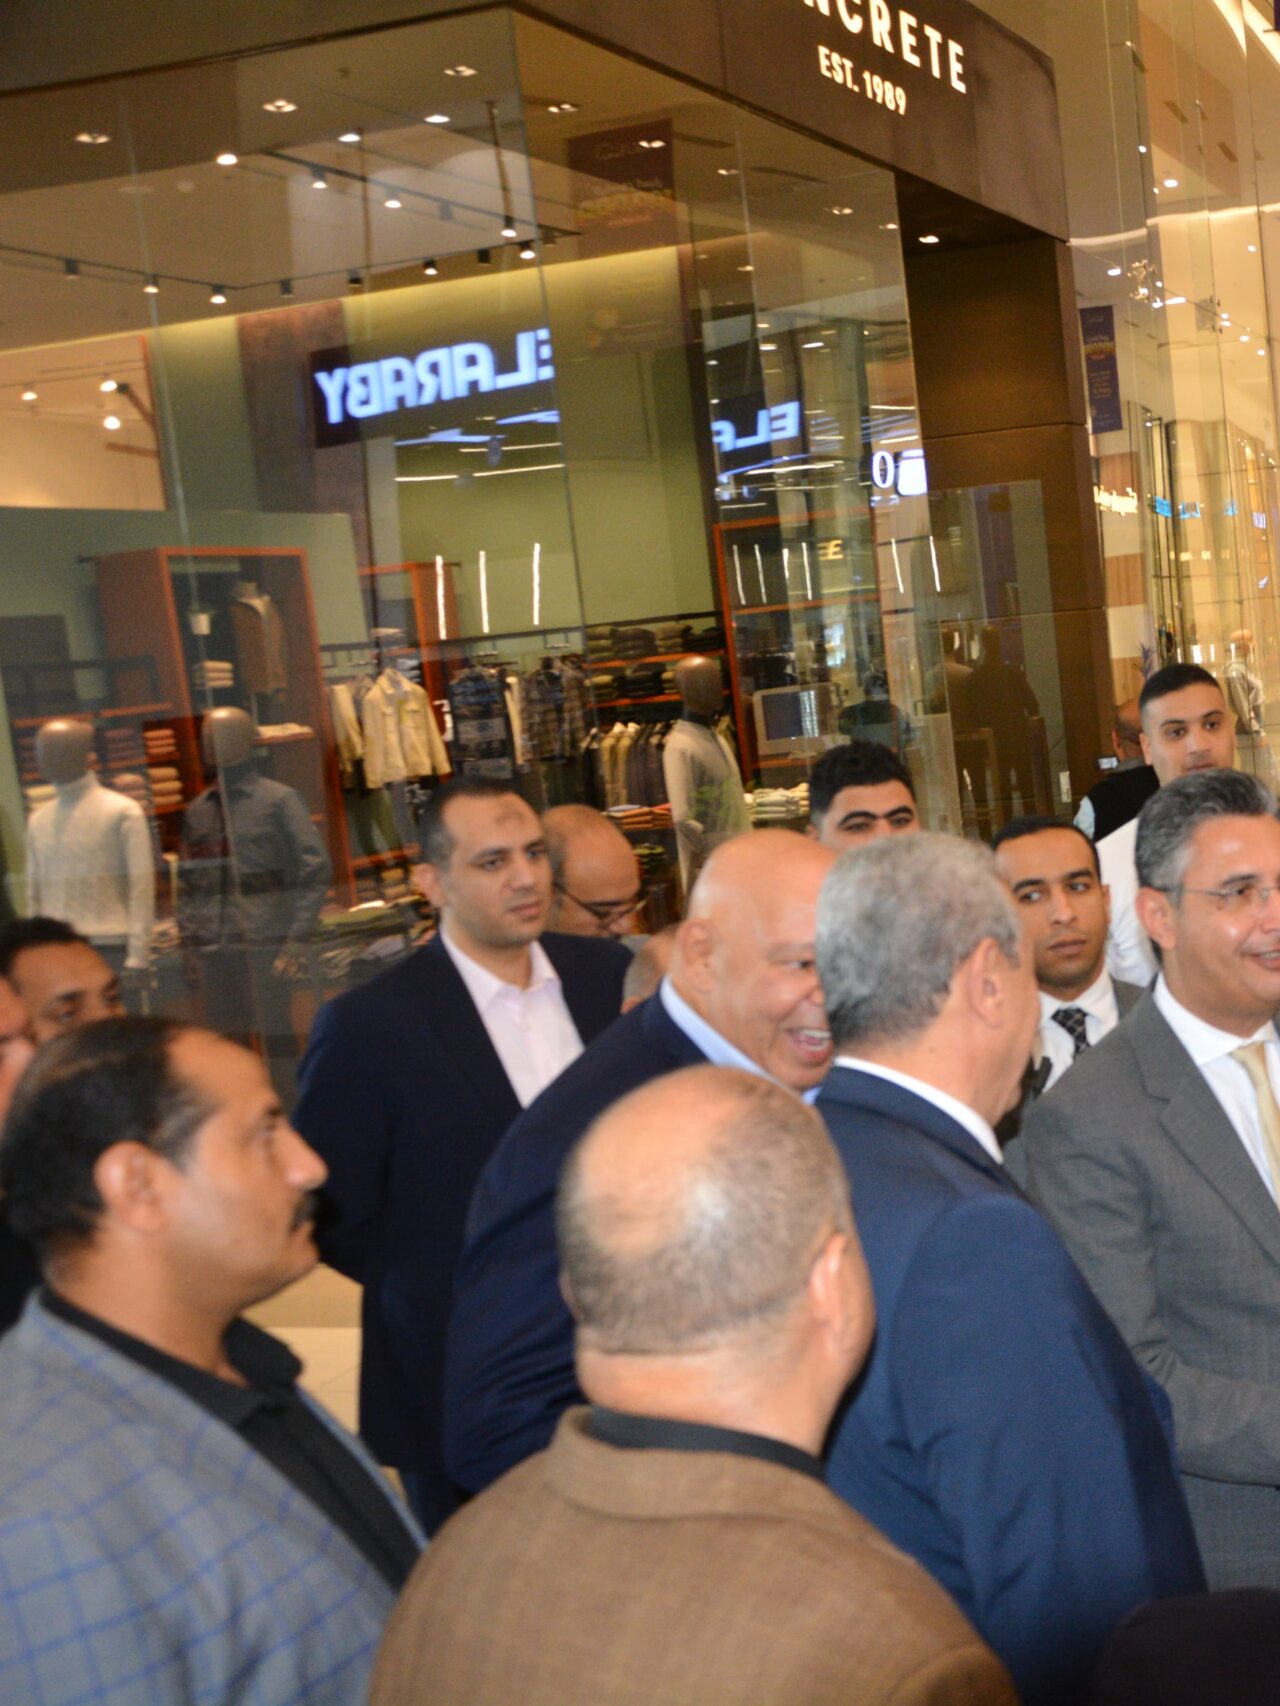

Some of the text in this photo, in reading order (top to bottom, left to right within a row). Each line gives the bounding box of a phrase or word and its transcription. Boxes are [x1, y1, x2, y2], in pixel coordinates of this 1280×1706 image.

[803, 0, 967, 94] CRETE
[818, 45, 907, 116] EST. 1989
